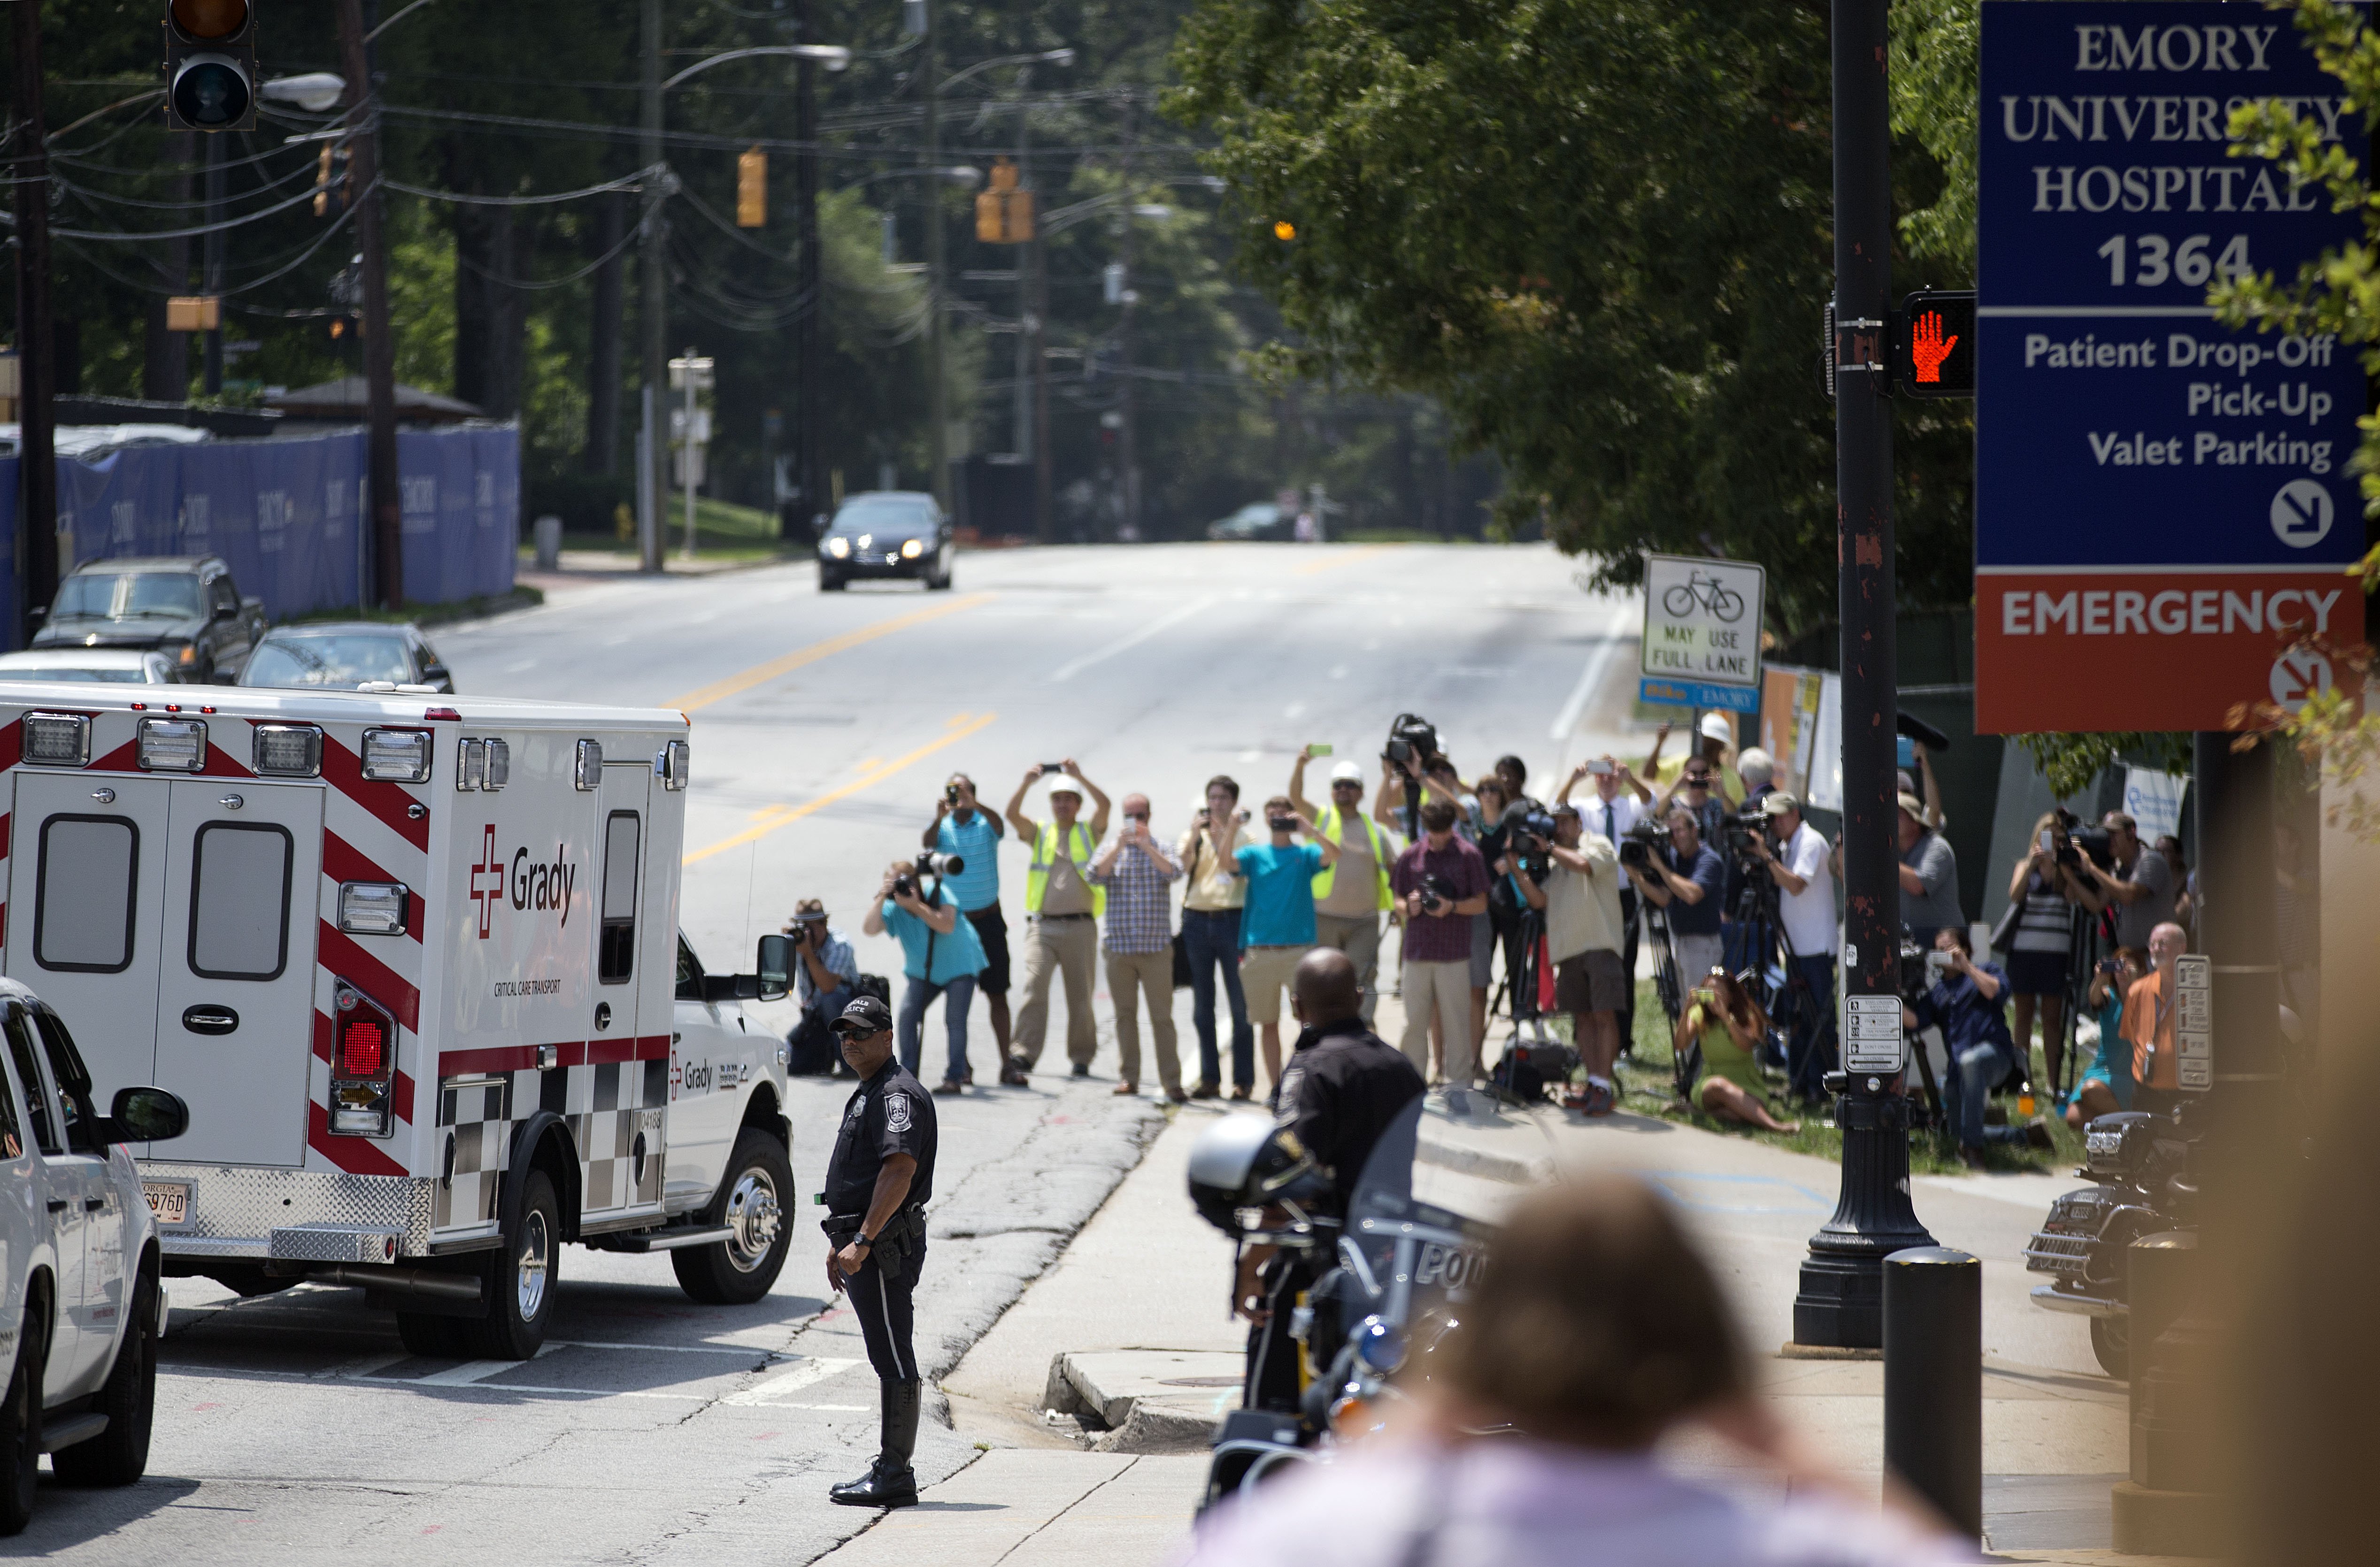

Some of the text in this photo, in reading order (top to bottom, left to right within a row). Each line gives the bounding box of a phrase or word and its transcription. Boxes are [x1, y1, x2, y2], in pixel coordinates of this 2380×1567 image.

[2074, 25, 2278, 71] EMORY
[2032, 166, 2317, 212] HOSPITAL
[2097, 234, 2252, 287] 1364
[2025, 334, 2335, 376] Patient Drop-Off
[2188, 383, 2333, 425] Pick-Up
[2088, 432, 2332, 474] Valet Parking
[2002, 589, 2341, 635] EMERGENCY
[1664, 625, 1739, 649] MAY USE
[1652, 649, 1747, 675] FULL LANE
[1703, 689, 1751, 707] EMORY
[511, 844, 575, 928] Grady
[494, 979, 561, 997] CRITICAL CARE TRANSPORT
[685, 1059, 712, 1095] Grady
[641, 1111, 661, 1130] 04188
[142, 1184, 172, 1193] ORGIA
